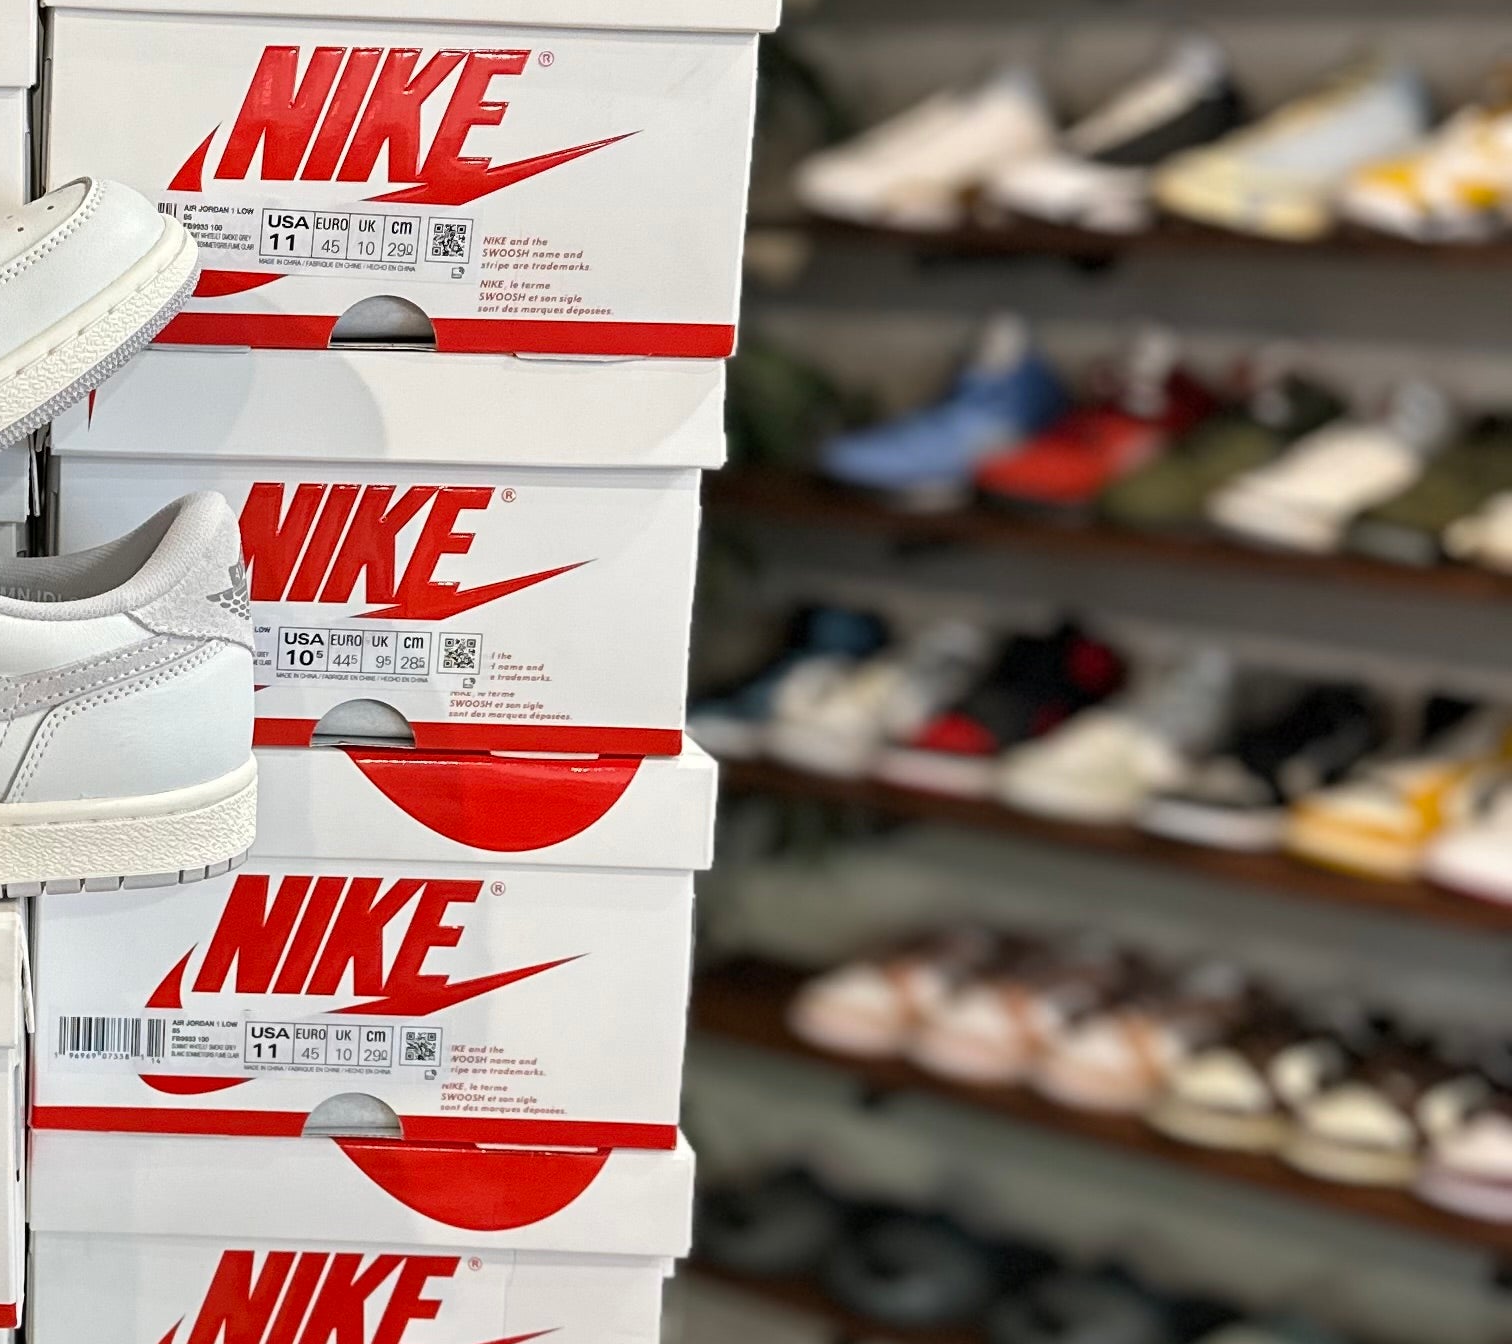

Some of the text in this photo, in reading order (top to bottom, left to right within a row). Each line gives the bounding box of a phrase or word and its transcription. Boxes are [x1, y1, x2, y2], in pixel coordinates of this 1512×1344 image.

[214, 45, 531, 183] NIKE
[268, 215, 412, 234] USA EURO UK cm
[270, 234, 295, 251] 11
[322, 240, 339, 254] 45
[358, 242, 375, 255] 10
[483, 237, 548, 246] NIKE and the
[482, 249, 529, 258] SWOOSH
[564, 250, 583, 258] and
[481, 262, 509, 270] stripe
[510, 281, 518, 289] le
[479, 293, 525, 301] SWOOSH
[529, 294, 538, 302] et
[560, 294, 582, 304] sigle
[502, 305, 518, 313] des
[521, 307, 564, 315] marques
[285, 633, 423, 648] USA EURO UK cm
[192, 874, 484, 997] NIKE
[251, 1027, 385, 1042] USA EURO UK cm
[253, 1044, 277, 1058] 11
[302, 1048, 319, 1059] 45
[337, 1049, 352, 1061] 10
